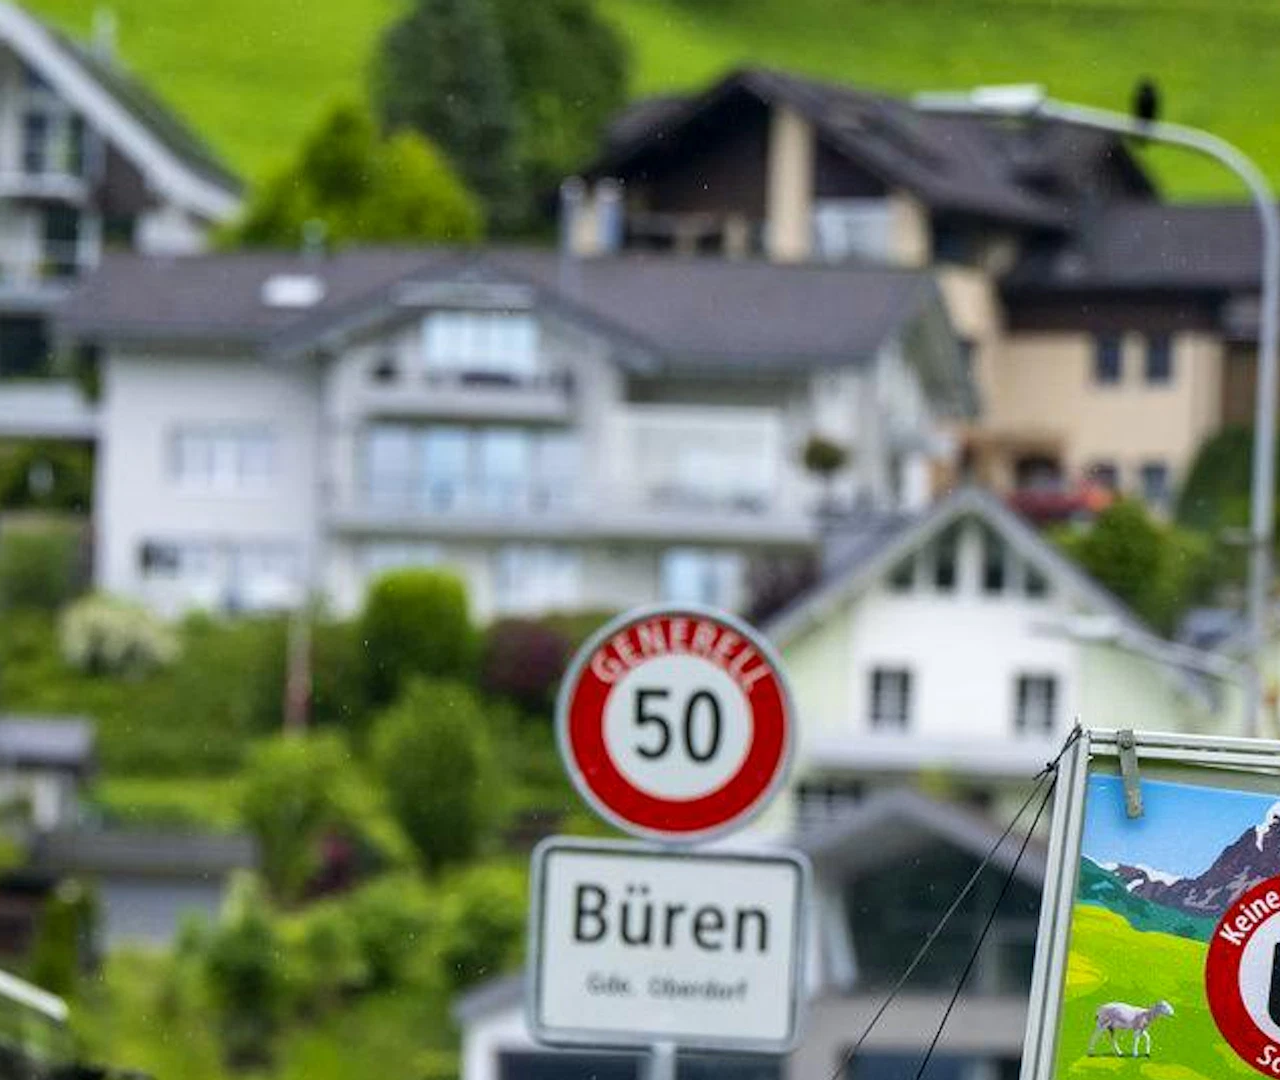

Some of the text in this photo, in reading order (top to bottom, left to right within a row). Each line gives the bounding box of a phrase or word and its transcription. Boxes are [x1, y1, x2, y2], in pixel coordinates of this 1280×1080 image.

[591, 616, 772, 695] GENERELL
[634, 687, 724, 764] 50
[572, 882, 770, 954] Büren
[1220, 889, 1280, 947] Keine
[585, 974, 749, 1002] Gde. Oberdorf
